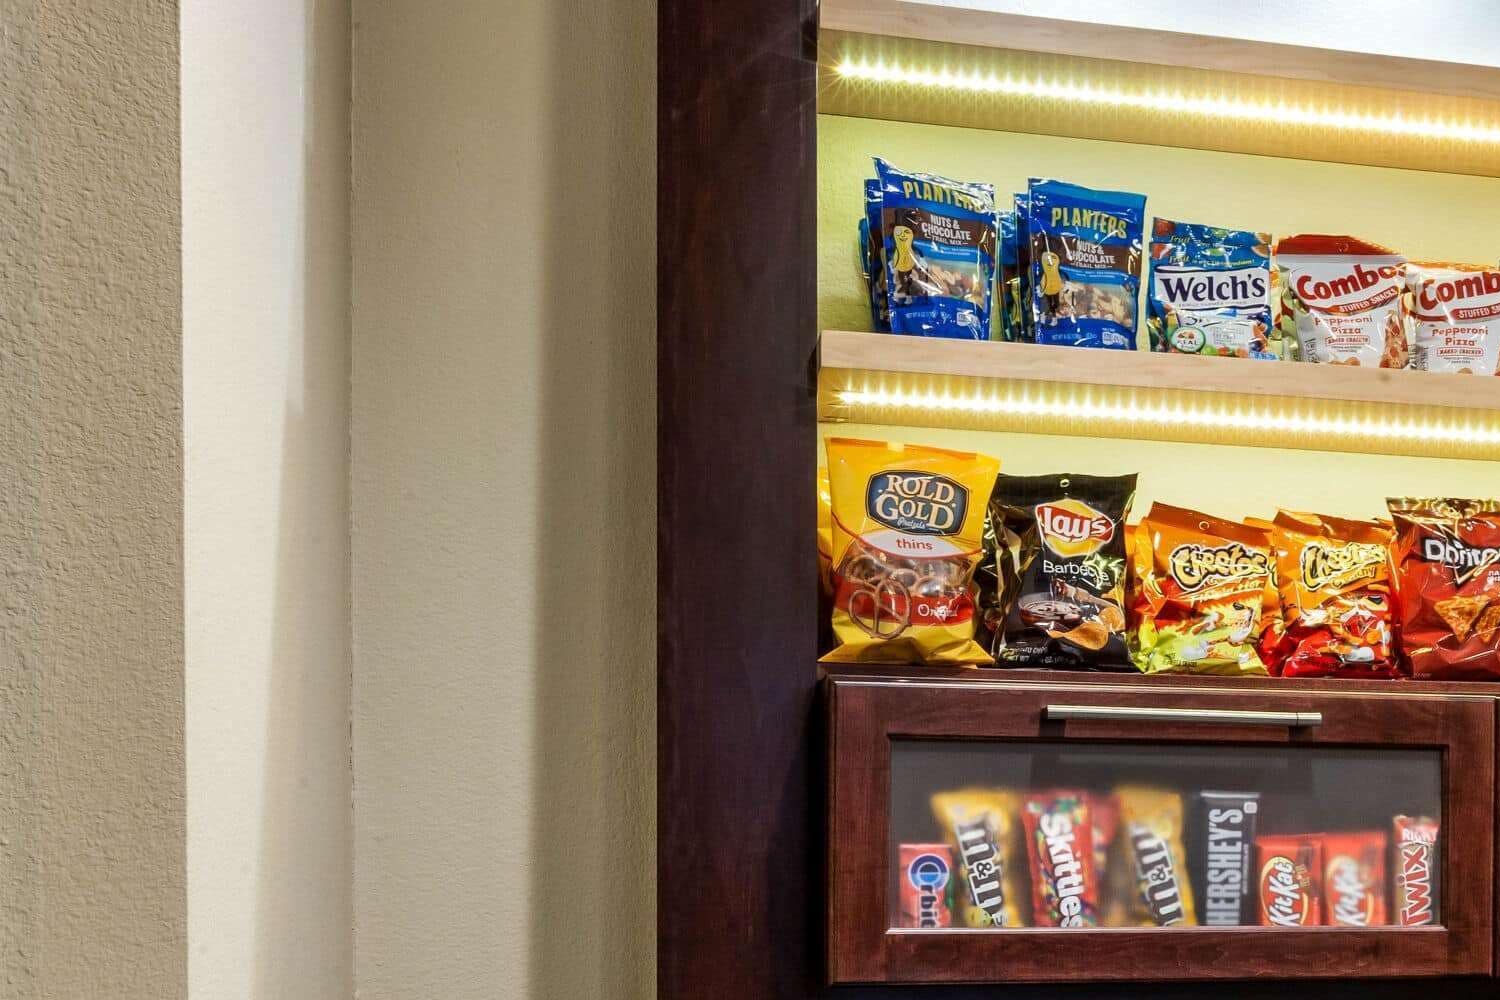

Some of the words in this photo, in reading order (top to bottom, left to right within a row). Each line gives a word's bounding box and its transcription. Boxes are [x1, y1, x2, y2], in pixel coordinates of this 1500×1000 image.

[930, 214, 953, 229] NUTS
[1051, 207, 1128, 239] PLANTERS
[921, 222, 972, 241] CHOCOLATE
[1076, 240, 1098, 254] NUTS
[1160, 273, 1266, 303] Welch's
[1459, 307, 1490, 319] STUFFED
[1431, 326, 1489, 337] Pepperoni
[1445, 337, 1476, 346] Pizza
[885, 474, 956, 504] ROLD
[875, 493, 955, 529] GOLD
[896, 516, 927, 529] Pretzels
[1043, 507, 1108, 541] Lay's
[895, 538, 933, 551] thins
[1206, 808, 1244, 926] HERSHEY'S
[1401, 845, 1431, 926] TWIX
